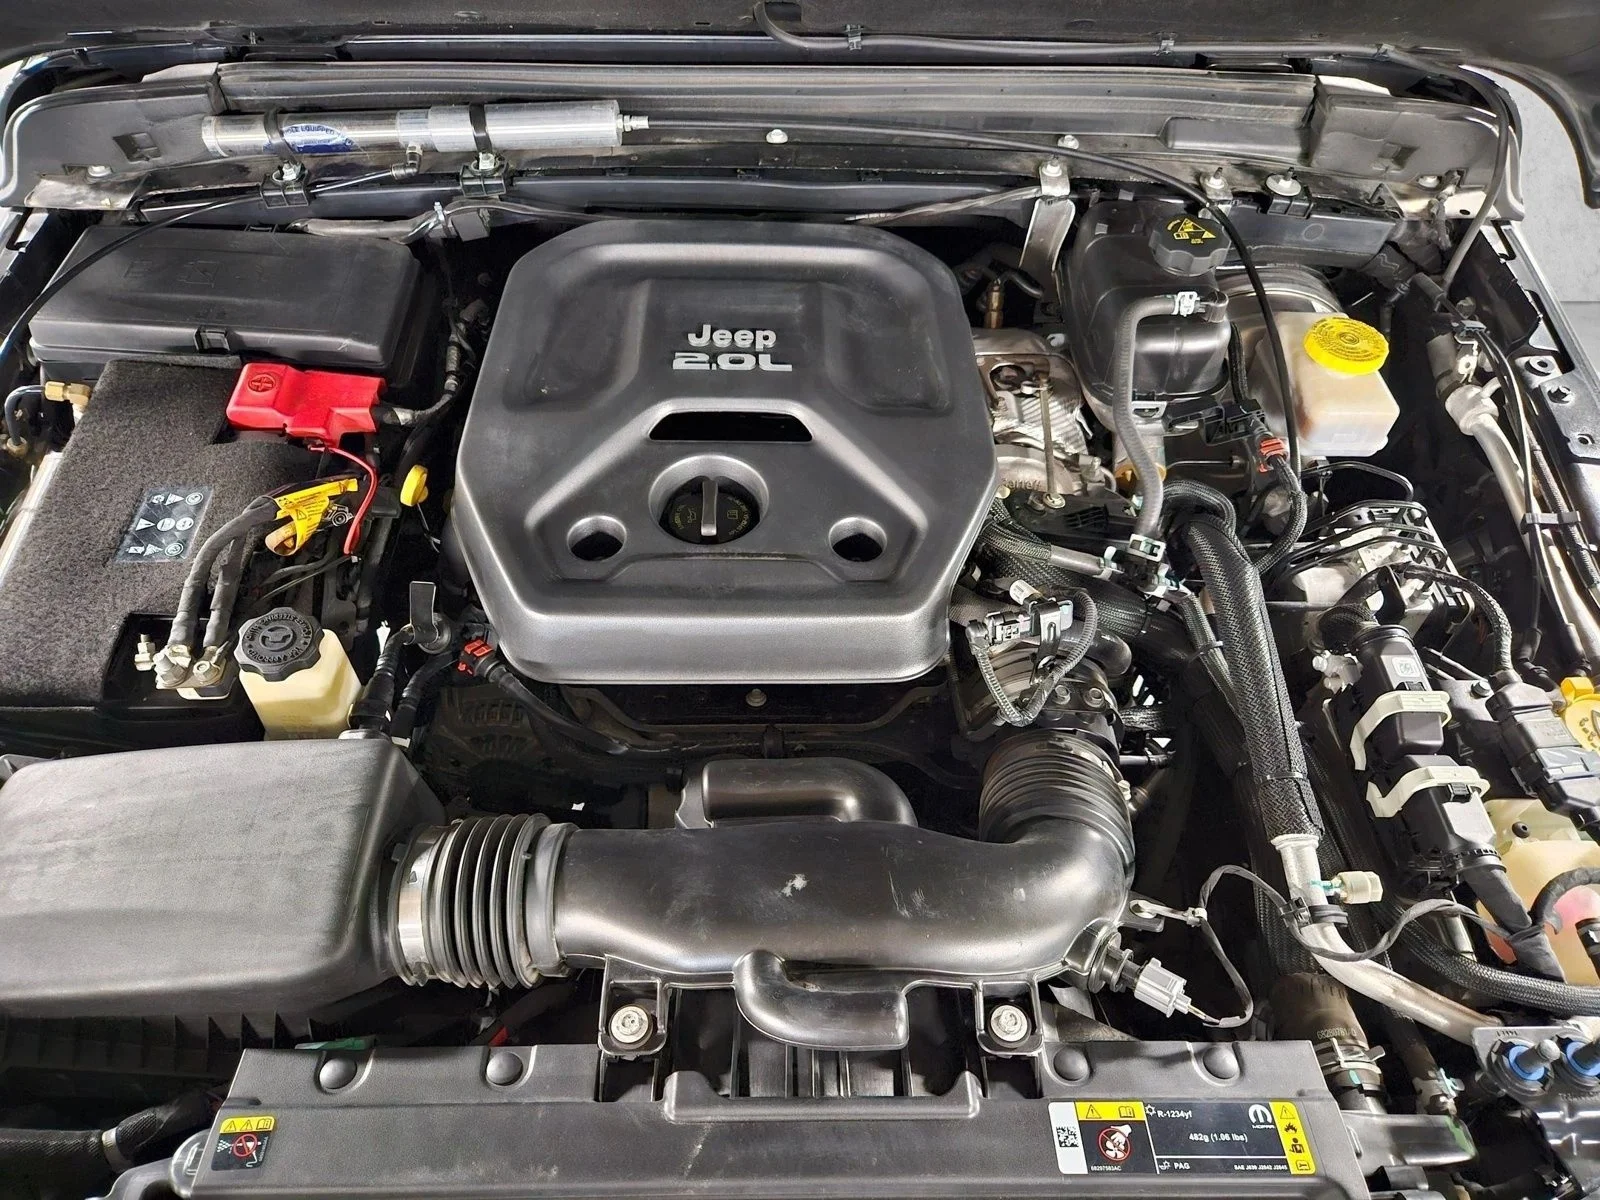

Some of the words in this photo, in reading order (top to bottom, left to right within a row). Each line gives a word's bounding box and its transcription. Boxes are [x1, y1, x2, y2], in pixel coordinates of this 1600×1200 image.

[688, 324, 776, 351] Jeep
[673, 352, 792, 371] 2.0L
[1157, 1109, 1193, 1120] R-1234yf
[1189, 1133, 1210, 1143] 482g
[1231, 1132, 1249, 1143] lbs)
[1173, 1162, 1190, 1170] PAG
